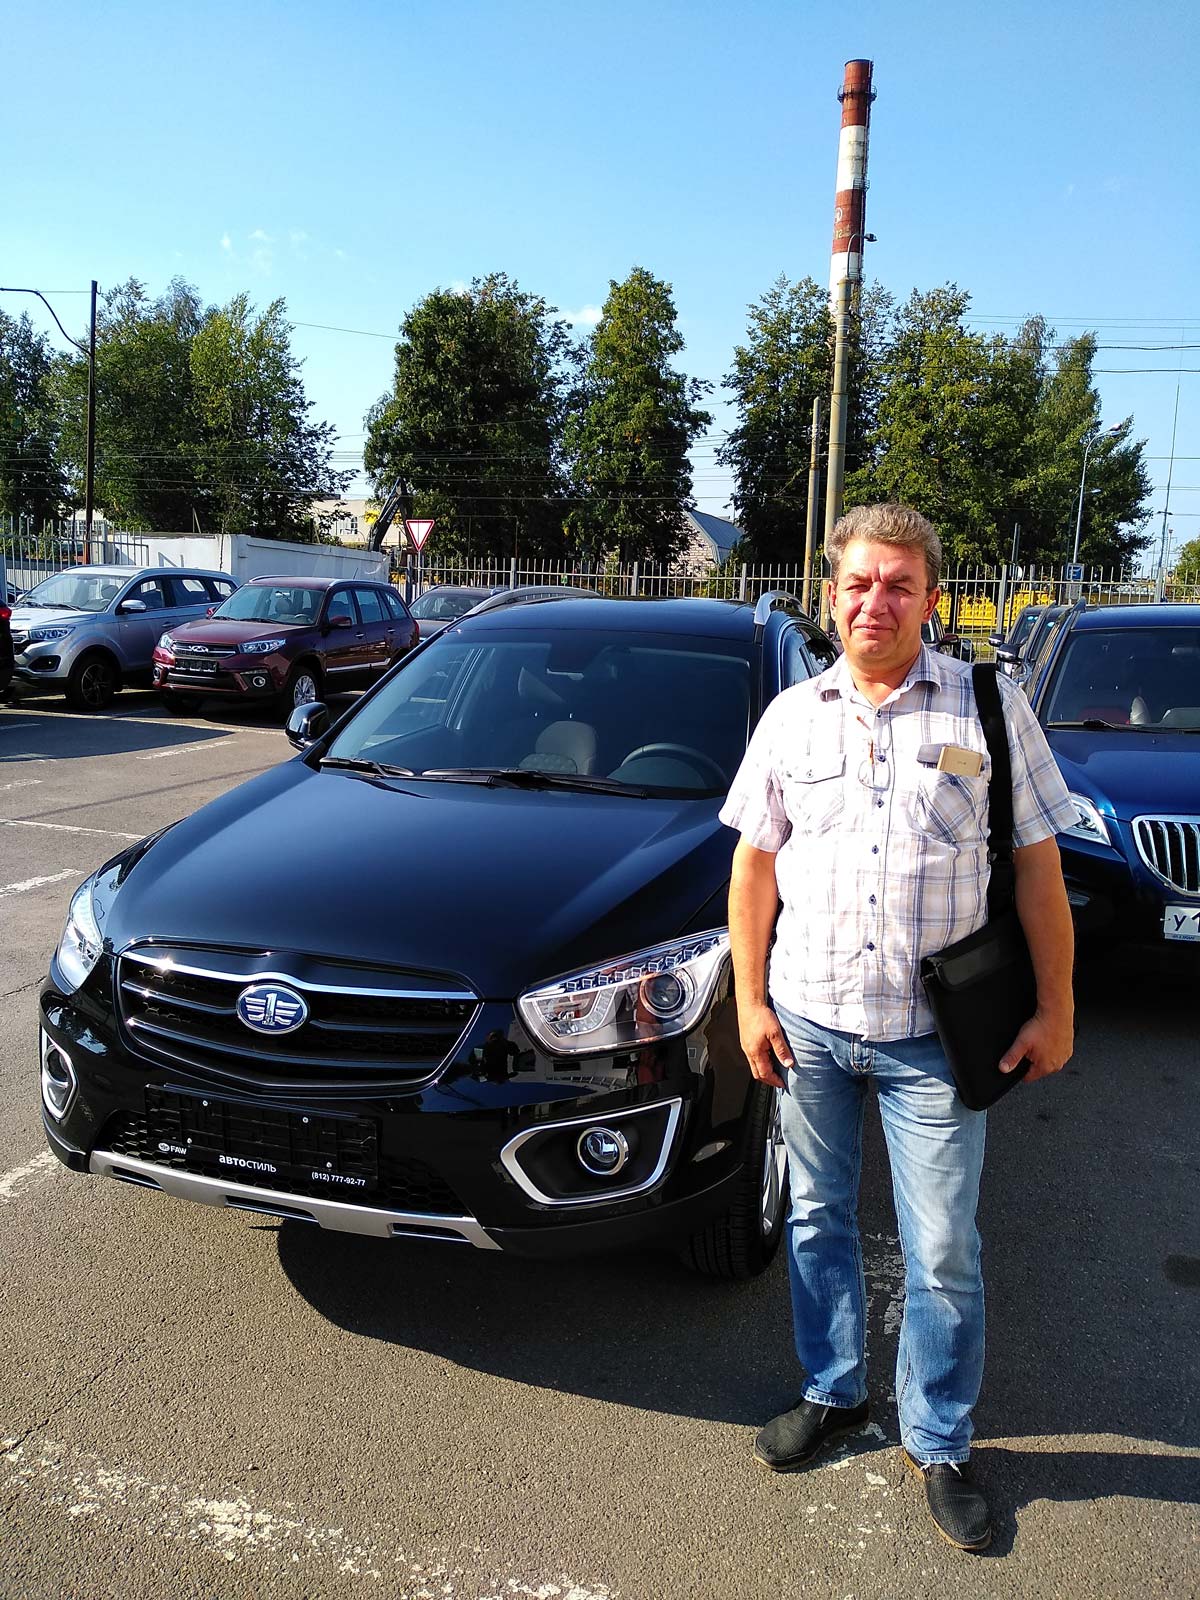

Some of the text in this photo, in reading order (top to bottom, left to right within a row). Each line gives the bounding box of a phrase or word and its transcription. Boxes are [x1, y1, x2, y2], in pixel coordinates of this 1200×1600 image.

[170, 1145, 187, 1155] FAW
[311, 1171, 366, 1186] (812) 777-92-77
